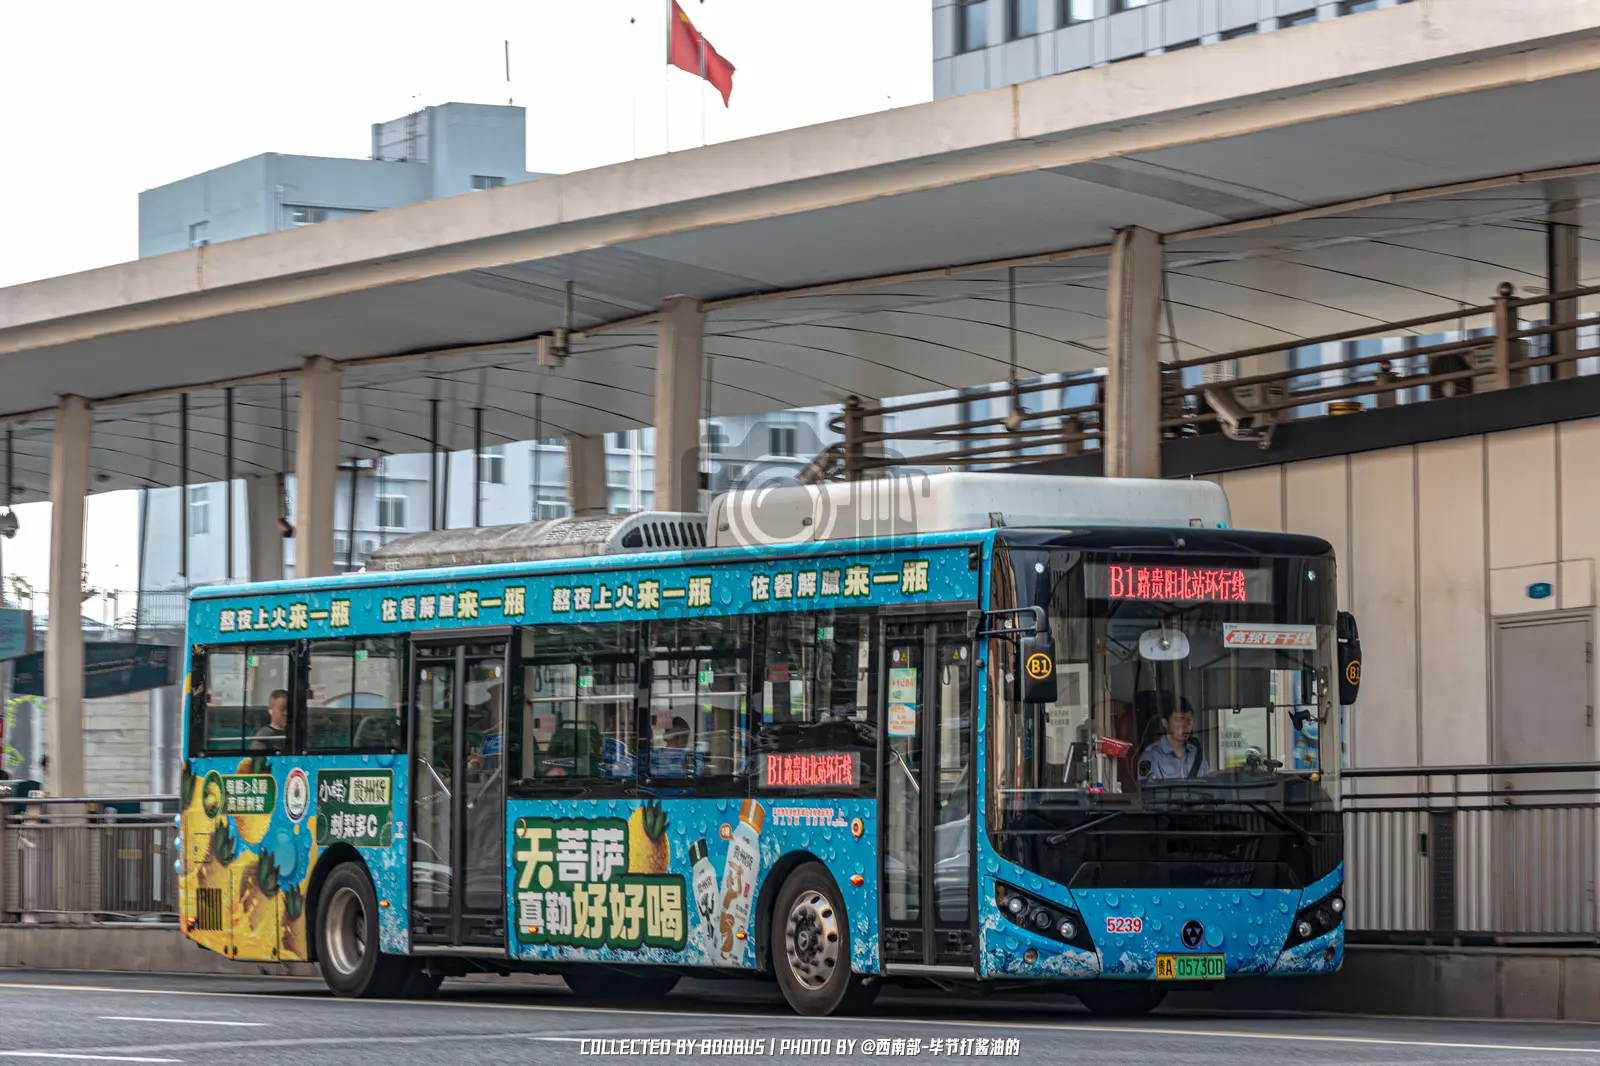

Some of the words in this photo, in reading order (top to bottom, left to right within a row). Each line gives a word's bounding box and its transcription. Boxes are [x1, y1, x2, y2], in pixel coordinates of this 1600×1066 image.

[552, 576, 712, 613] 熬夜上火来一瓶
[751, 560, 929, 601] 佐餐解腻来一瓶
[1109, 564, 1246, 602] B1路贵阳北站环行线
[219, 599, 351, 634] 熬夜上火来一瓶
[1031, 660, 1049, 674] B1
[1349, 665, 1361, 680] B1
[767, 753, 852, 786] B1路贵阳北站环行线
[516, 826, 625, 889] 天菩萨
[1106, 917, 1143, 933] 5239
